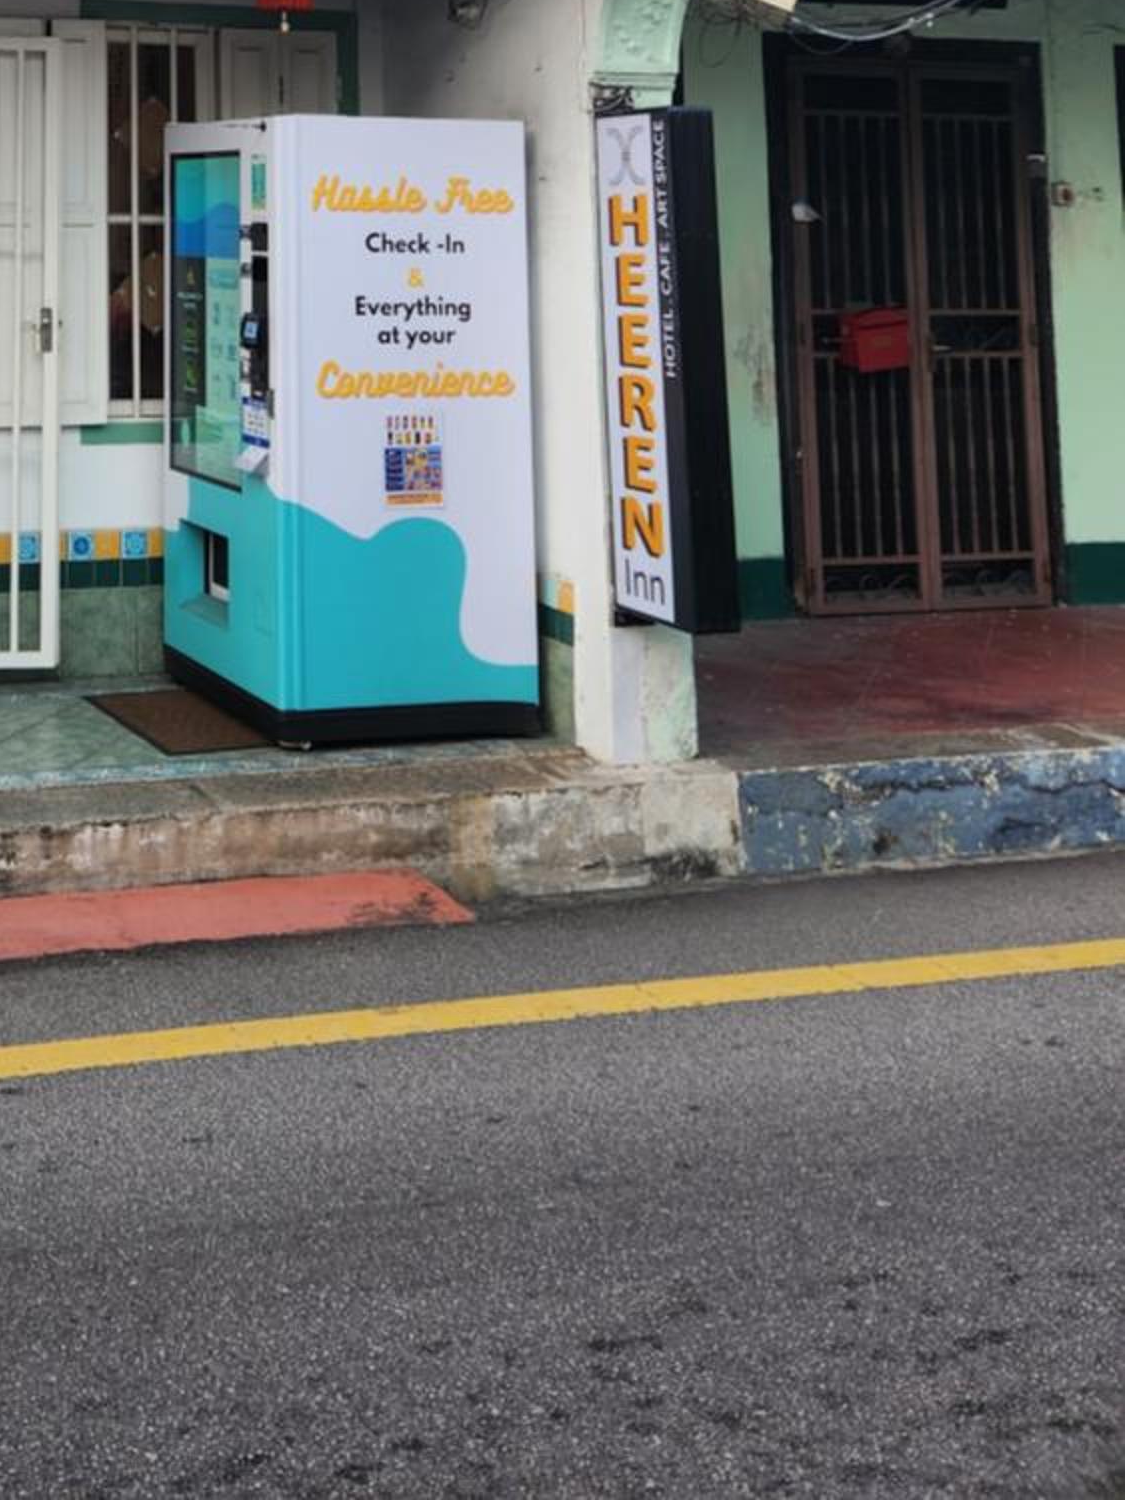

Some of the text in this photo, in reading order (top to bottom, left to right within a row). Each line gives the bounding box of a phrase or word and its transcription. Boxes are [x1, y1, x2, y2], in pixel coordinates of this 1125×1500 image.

[311, 173, 514, 215] Hassle Free
[364, 232, 431, 253] Check
[653, 120, 676, 378] HOTEL CAFE ART SPACE
[408, 267, 424, 288] &
[354, 295, 472, 322] Everything
[377, 327, 456, 350] at your
[315, 360, 515, 399] Convenience
[607, 193, 666, 558] HEEREN
[624, 558, 666, 606] Inn
